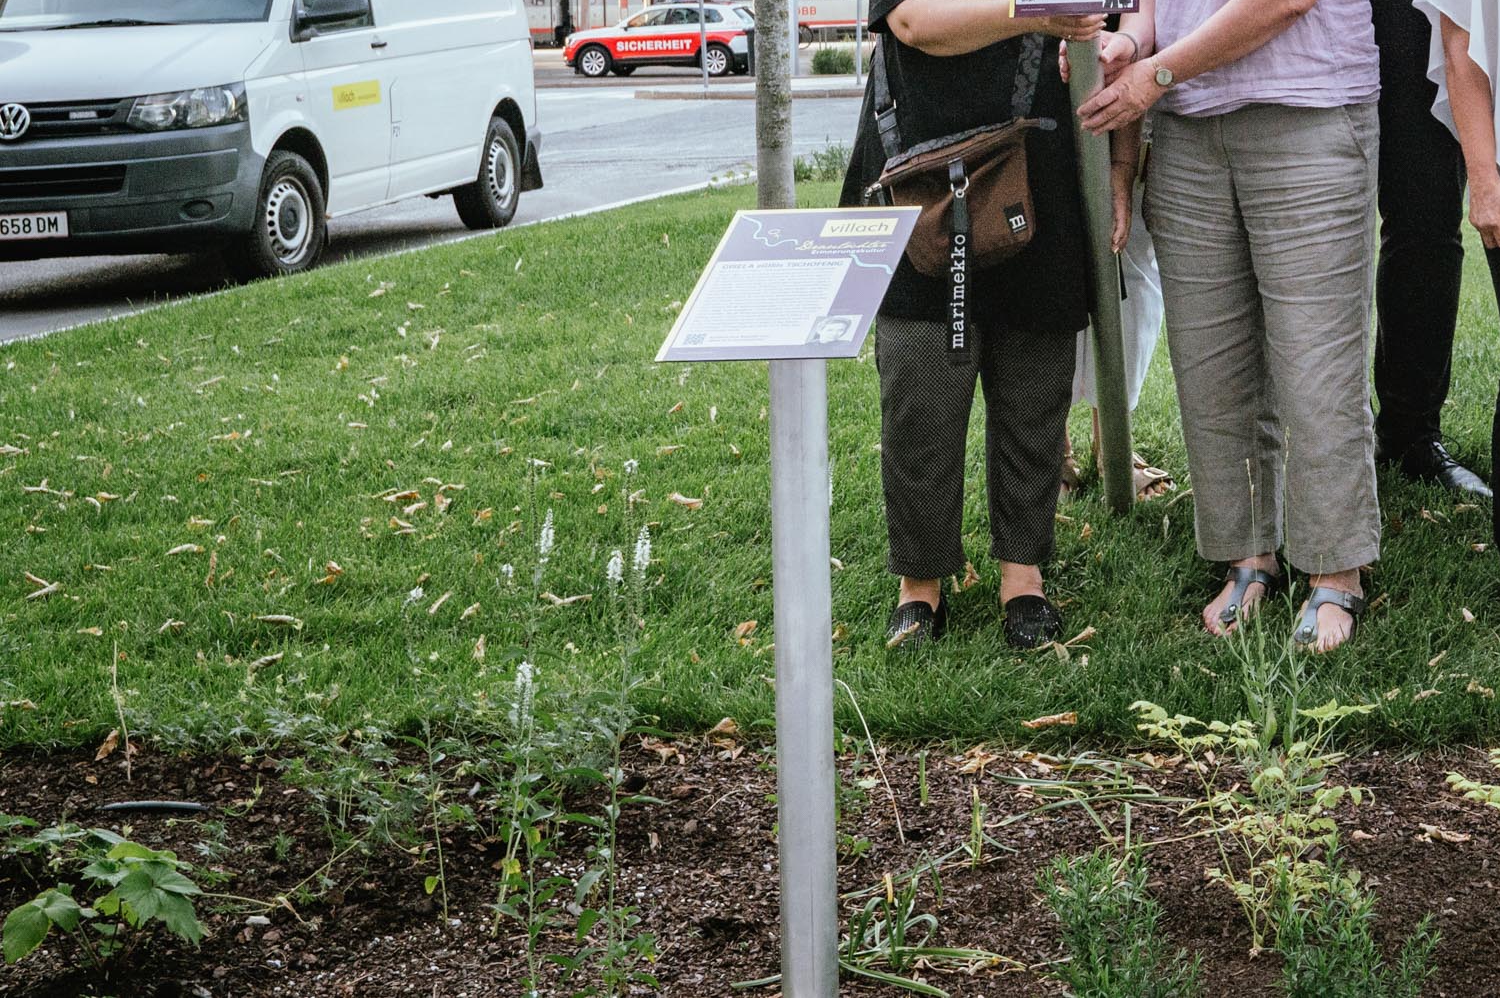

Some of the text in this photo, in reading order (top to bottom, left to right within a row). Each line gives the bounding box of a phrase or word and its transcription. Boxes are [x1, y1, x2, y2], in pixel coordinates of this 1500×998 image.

[616, 39, 692, 52] SICHERHEIT
[37, 215, 58, 233] DM
[829, 223, 889, 233] villach
[1009, 214, 1026, 229] m
[951, 233, 966, 349] marimekko
